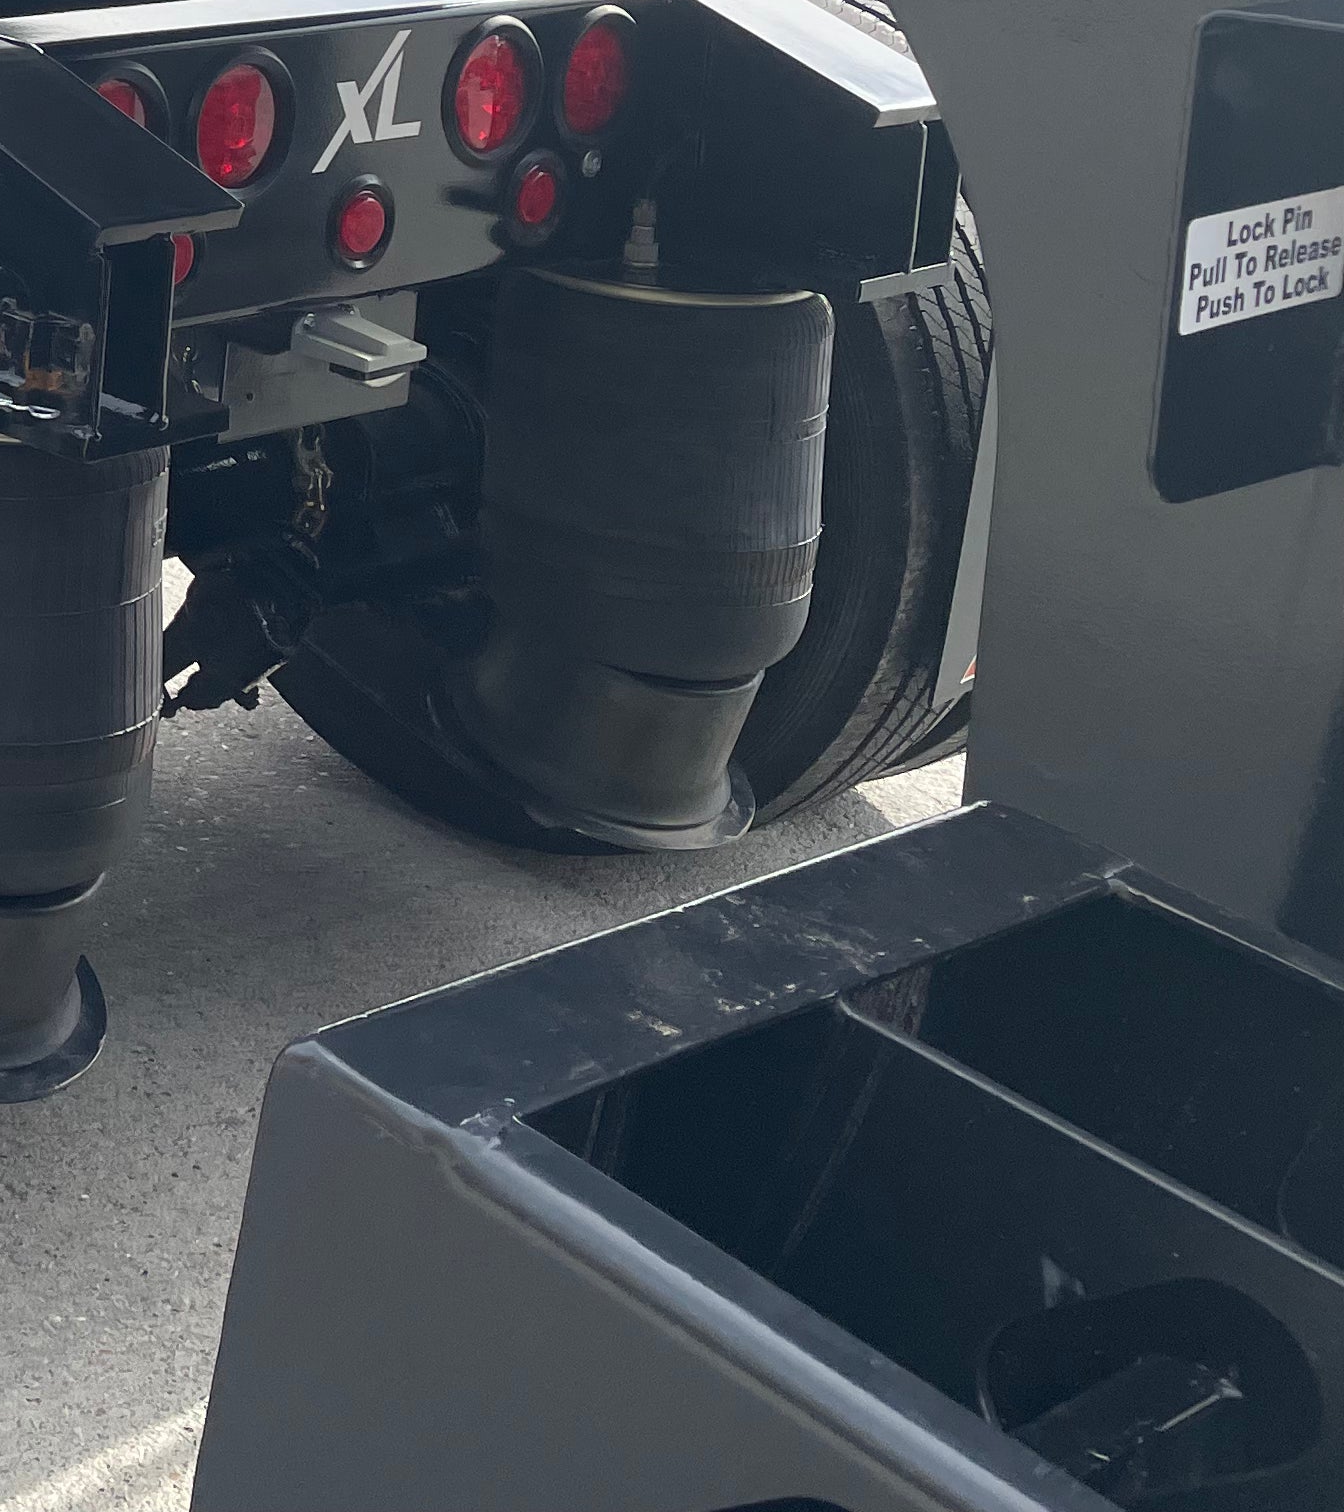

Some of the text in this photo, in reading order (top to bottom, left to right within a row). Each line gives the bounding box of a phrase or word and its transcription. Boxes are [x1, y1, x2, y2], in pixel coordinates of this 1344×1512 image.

[312, 29, 421, 174] XL
[1226, 205, 1313, 248] Lock Pin
[1188, 234, 1343, 291] Pull To Release
[1195, 266, 1330, 323] Push To Lock
